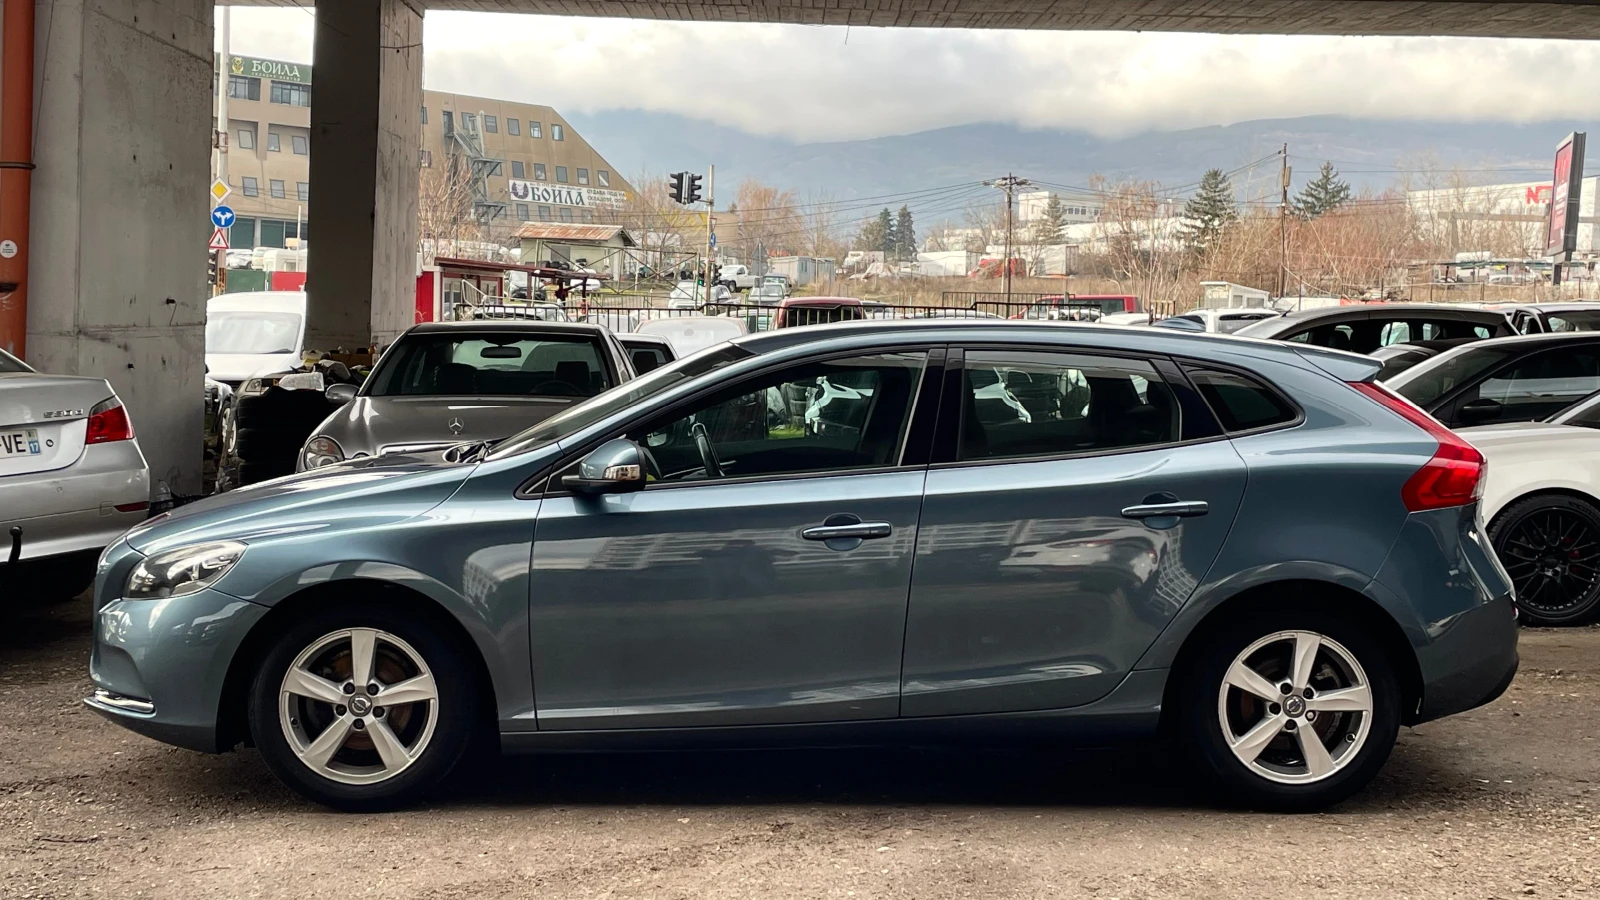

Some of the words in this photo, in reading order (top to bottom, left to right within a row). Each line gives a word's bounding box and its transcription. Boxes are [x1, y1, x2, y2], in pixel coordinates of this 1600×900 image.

[252, 60, 301, 77] БОИЛА
[530, 187, 585, 206] БОИЛА
[30, 442, 39, 452] 17
